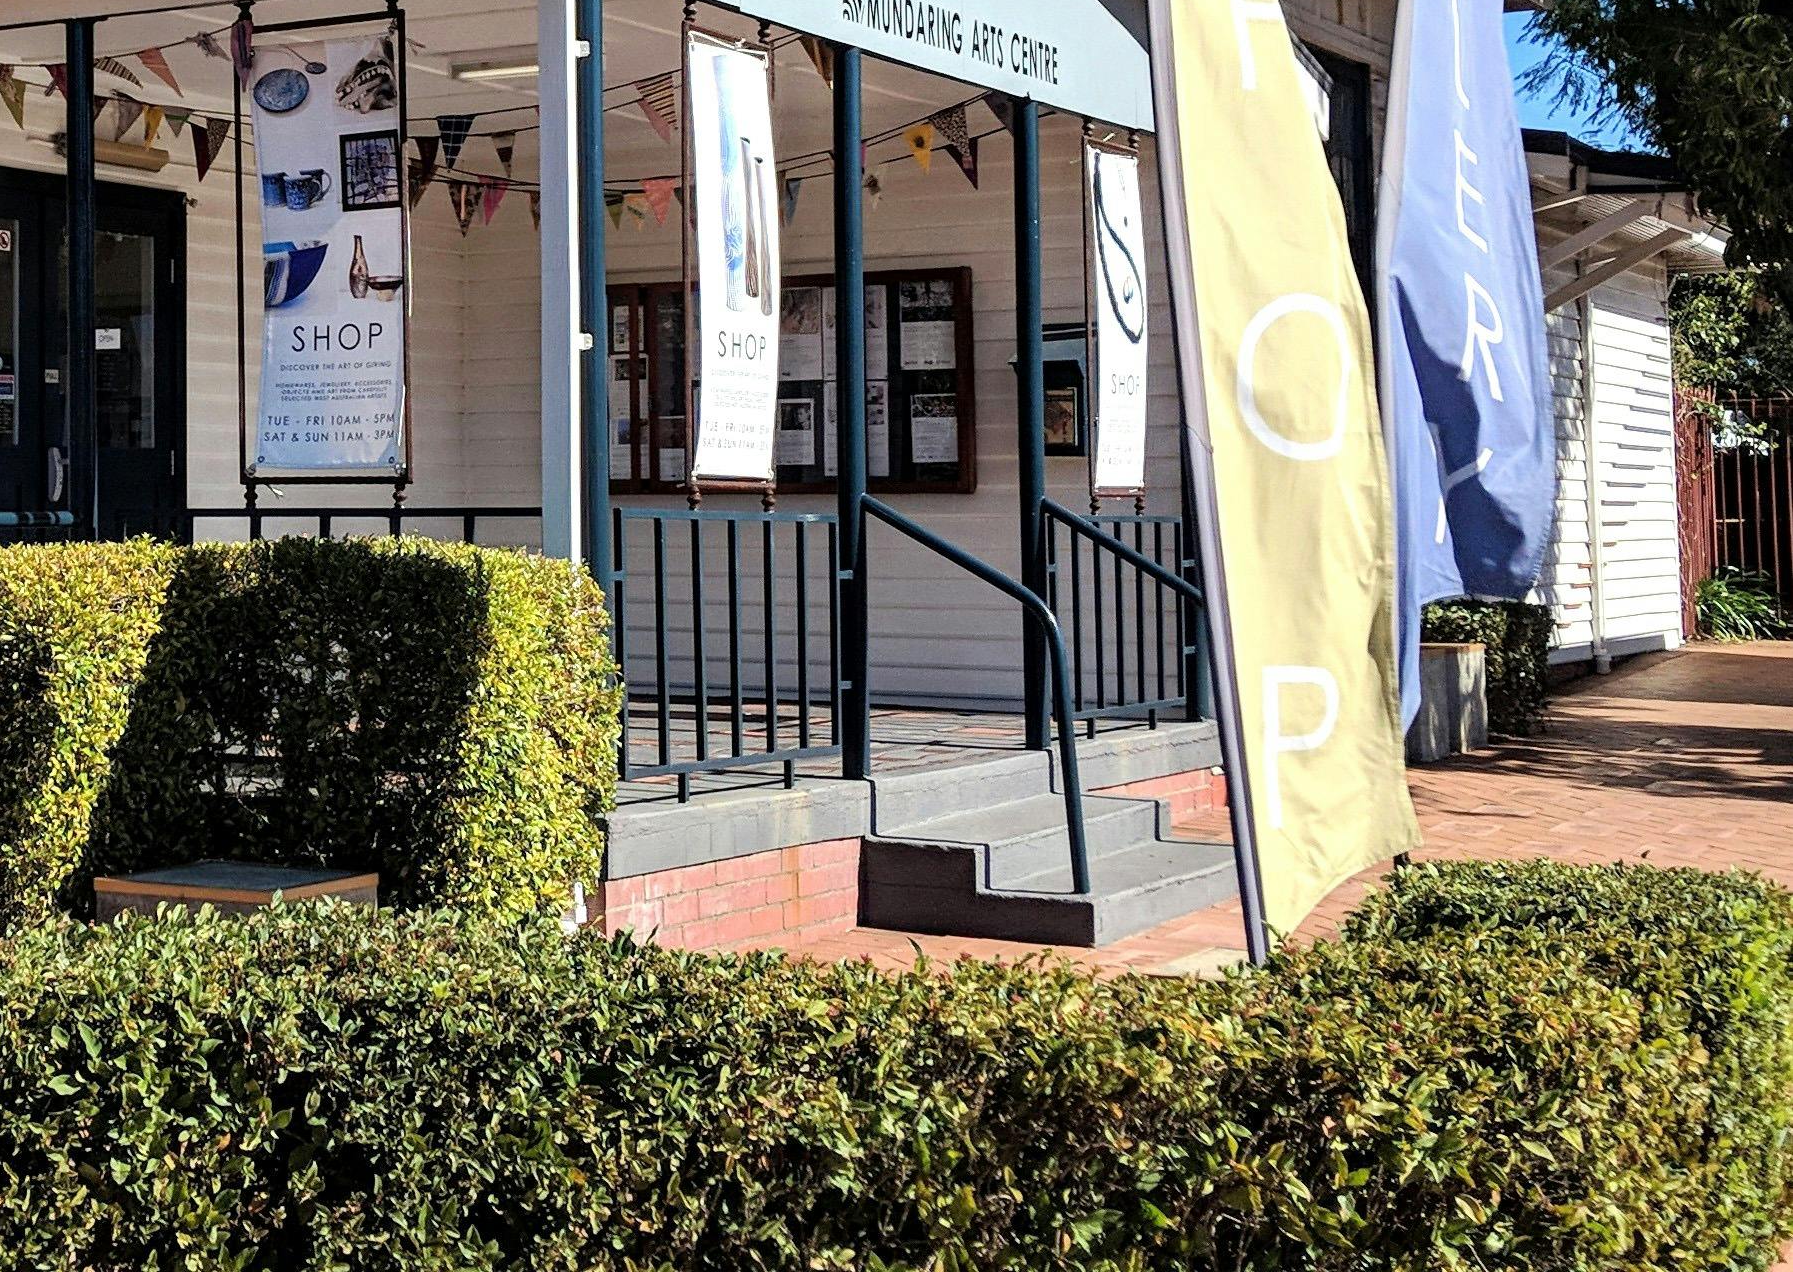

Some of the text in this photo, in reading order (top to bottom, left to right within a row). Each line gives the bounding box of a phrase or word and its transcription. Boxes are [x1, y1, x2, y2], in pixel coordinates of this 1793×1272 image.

[972, 19, 1003, 69] ARTS
[1011, 33, 1058, 85] CENTRE
[291, 322, 383, 352] SHOP
[717, 330, 767, 360] SHOP
[280, 363, 320, 372] DISCOVER
[353, 361, 363, 369] OF
[267, 415, 290, 426] TUE
[306, 415, 324, 426] FRI
[331, 415, 361, 425] 10AM
[374, 413, 395, 423] 5PM
[264, 431, 286, 442] SAT
[291, 432, 299, 442] &
[305, 432, 329, 443] SUN
[334, 431, 363, 441] 11AM
[374, 429, 395, 440] 3PM
